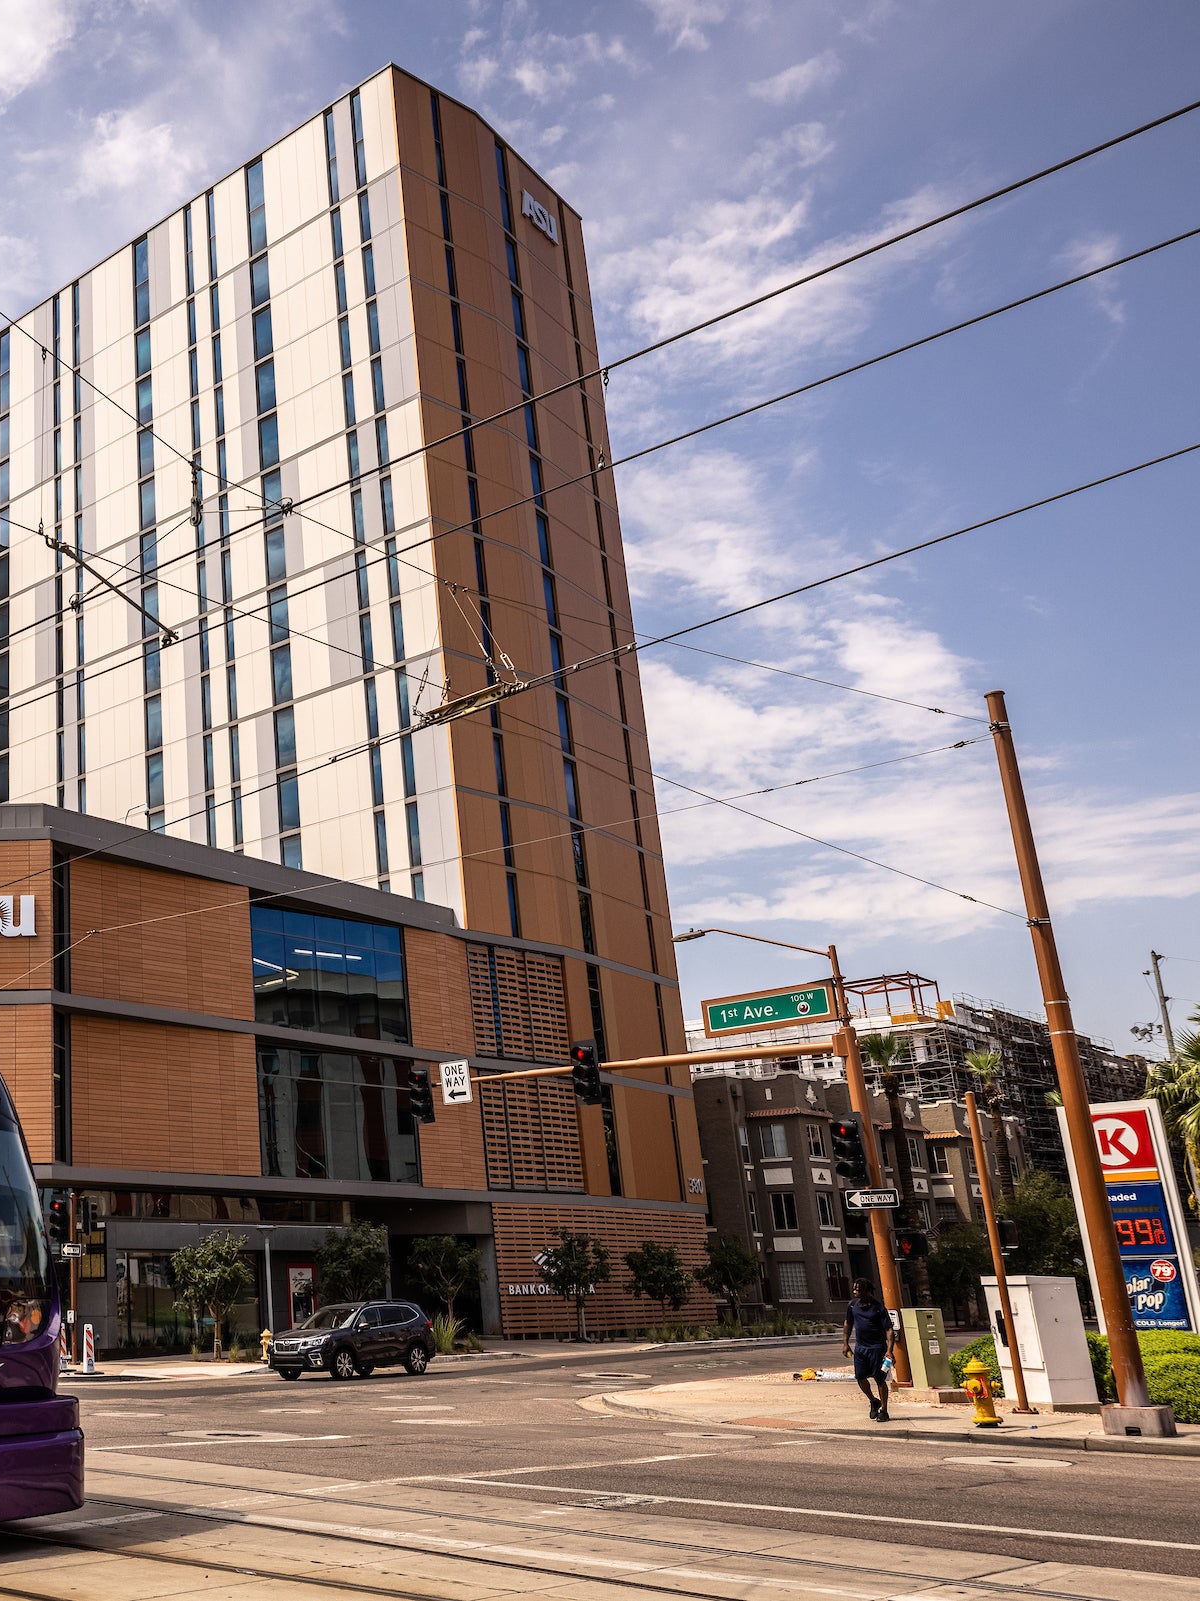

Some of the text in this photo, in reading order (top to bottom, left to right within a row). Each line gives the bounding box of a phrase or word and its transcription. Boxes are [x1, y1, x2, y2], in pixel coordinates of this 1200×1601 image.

[521, 186, 560, 246] ASU
[790, 992, 814, 1003] 100 W
[720, 1005, 779, 1023] 1st Ave.
[444, 1064, 464, 1077] ONE
[445, 1075, 466, 1088] WAY
[1097, 1127, 1137, 1164] K
[860, 1194, 892, 1203] ONE WAY
[1107, 1192, 1137, 1202] eaded
[1116, 1218, 1154, 1245] 99
[508, 1284, 537, 1295] BANK
[1126, 1276, 1151, 1295] olar
[1137, 1292, 1164, 1311] Pop
[1136, 1319, 1156, 1327] COLD
